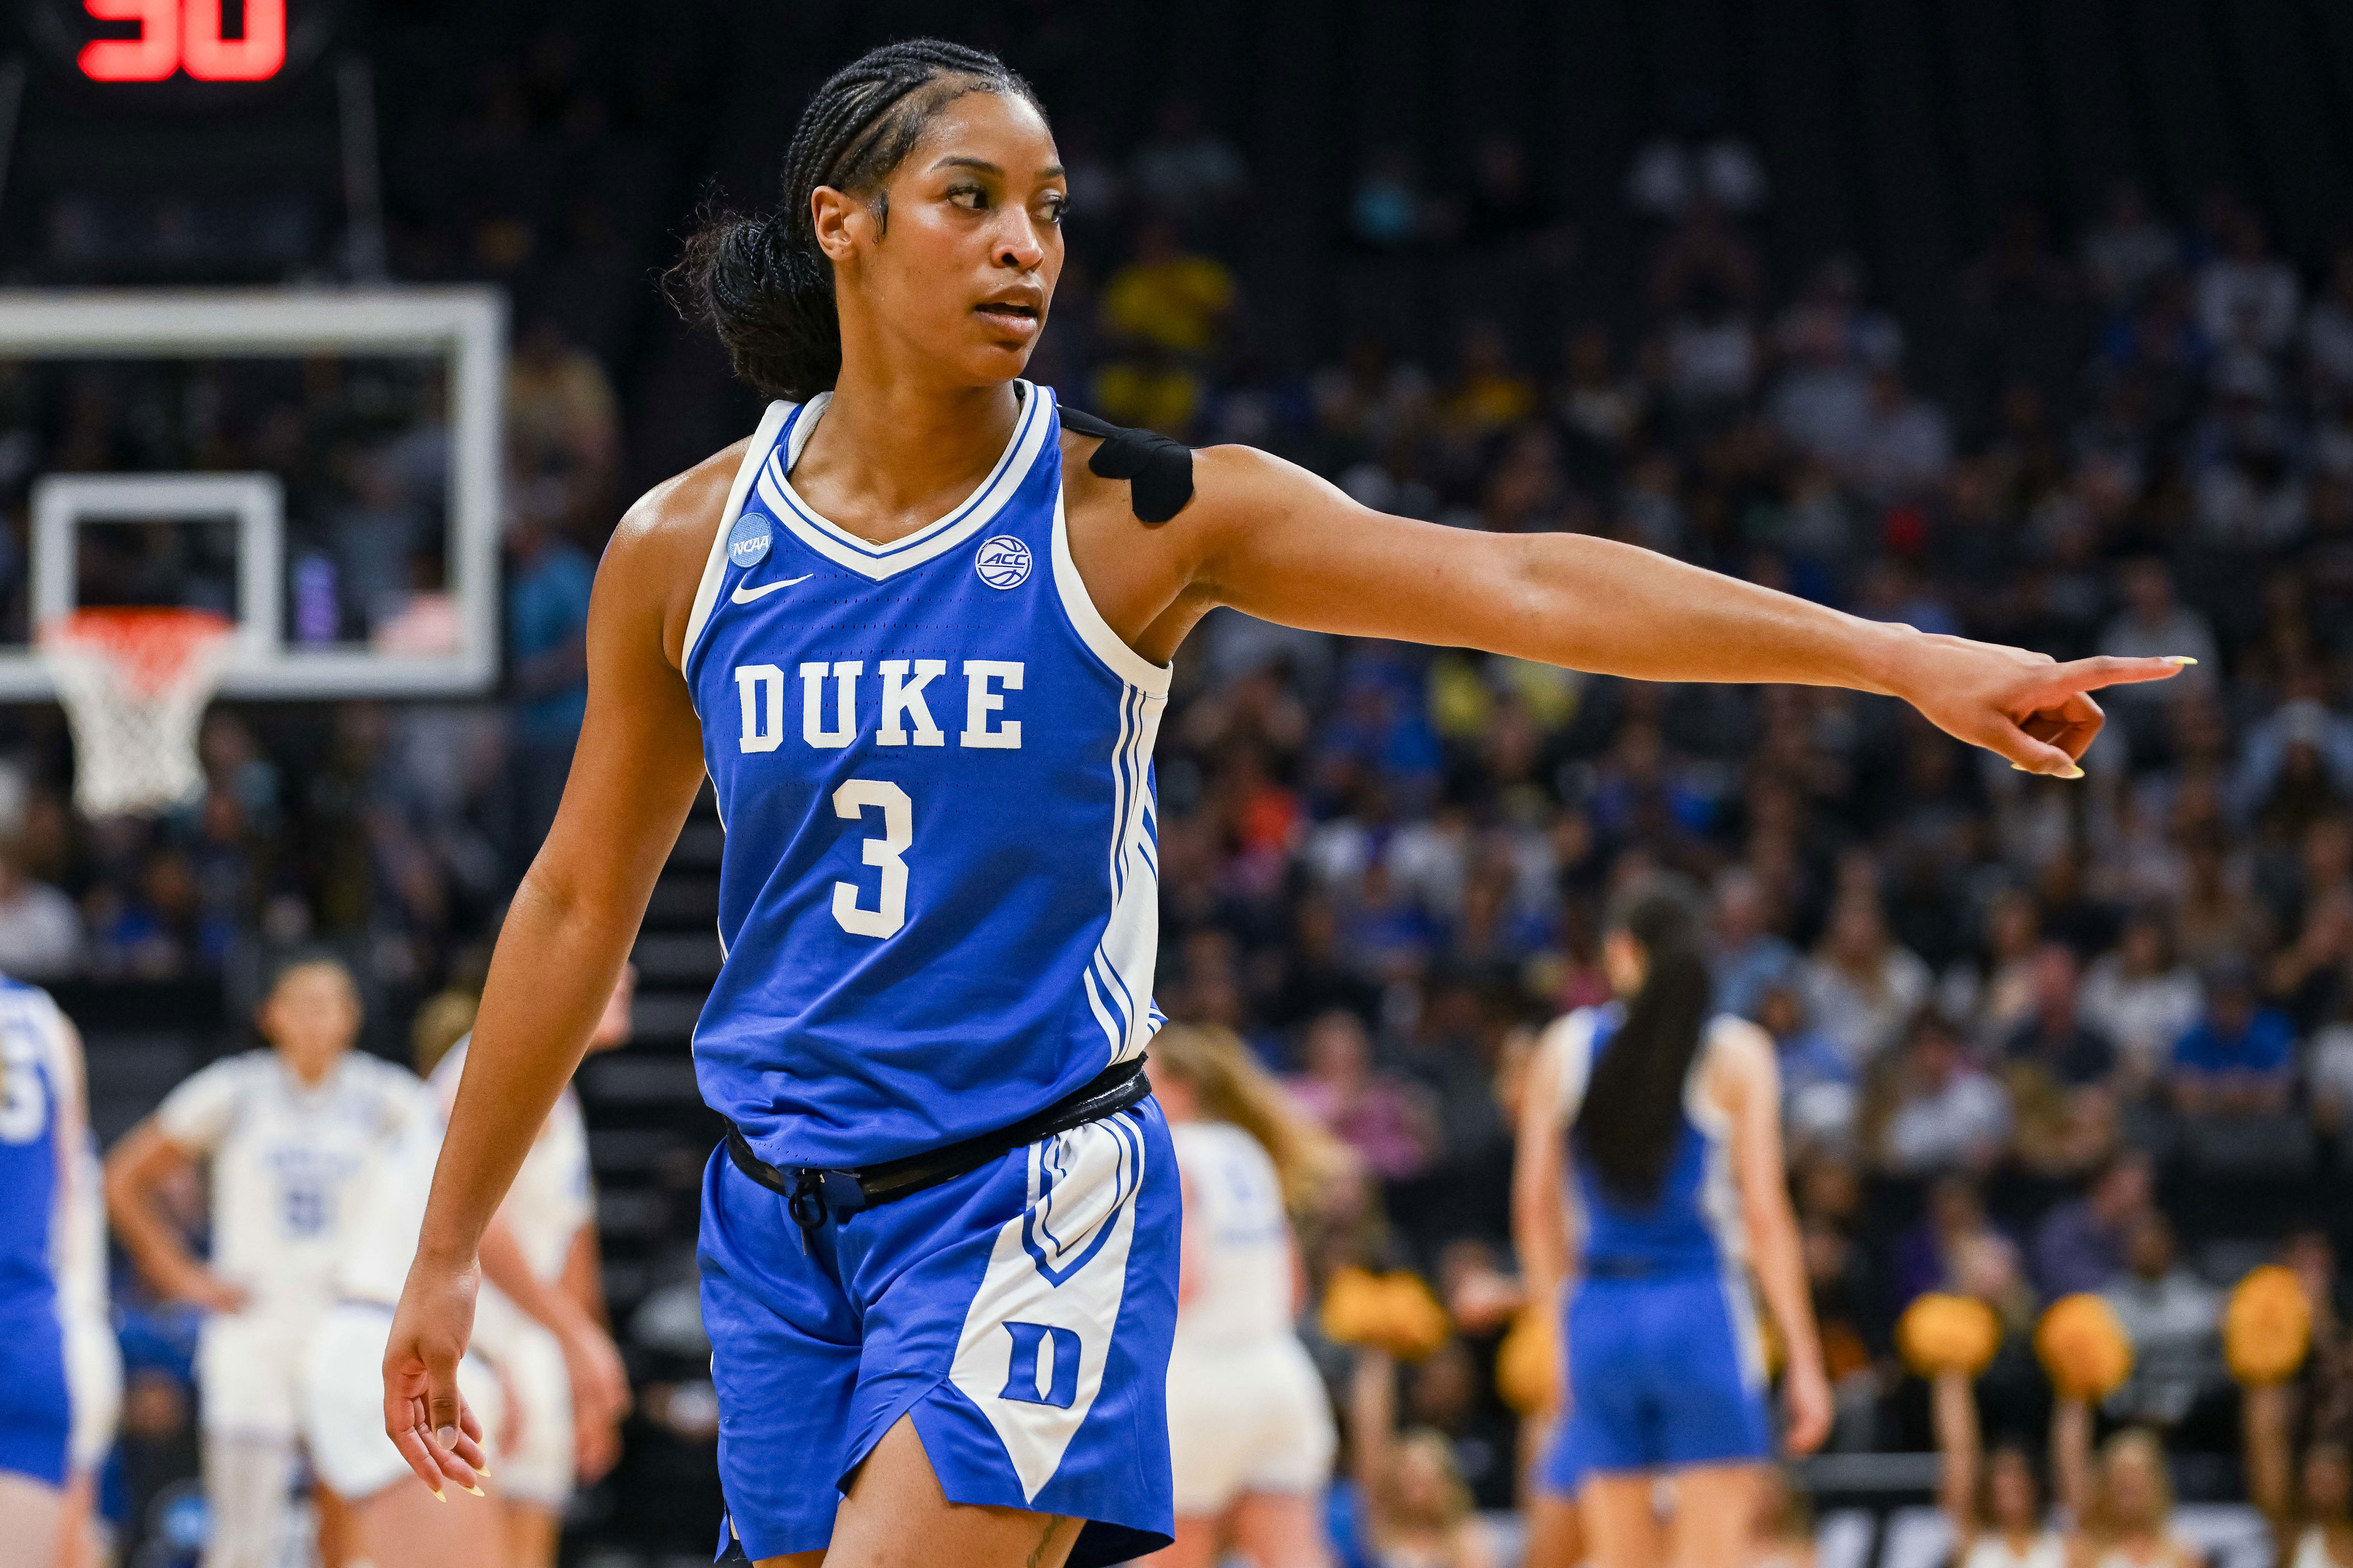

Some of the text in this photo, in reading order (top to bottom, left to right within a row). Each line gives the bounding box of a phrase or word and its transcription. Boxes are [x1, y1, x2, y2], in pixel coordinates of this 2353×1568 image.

[733, 535, 769, 556] NCAA
[984, 553, 1029, 565] ACC
[735, 660, 1024, 753] DUKE
[832, 779, 913, 939] 3
[998, 1321, 1081, 1409] D
